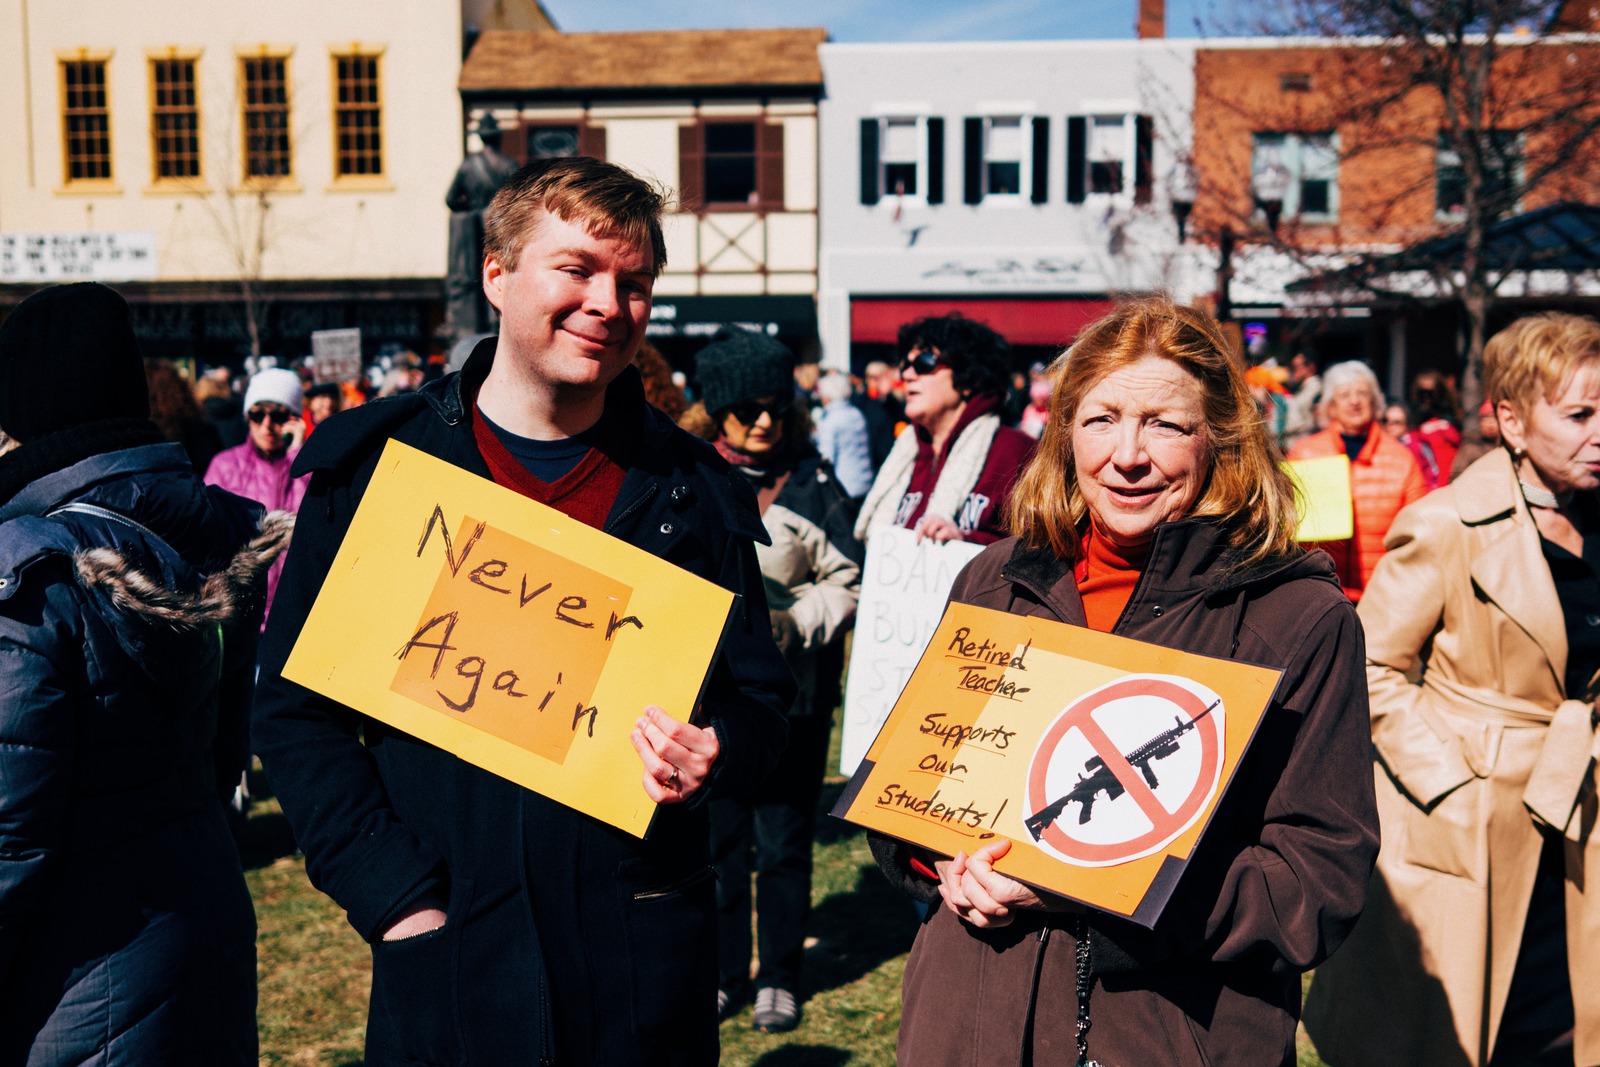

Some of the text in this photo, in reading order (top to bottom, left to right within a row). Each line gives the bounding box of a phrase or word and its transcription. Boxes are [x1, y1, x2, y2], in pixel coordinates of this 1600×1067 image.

[416, 502, 644, 642] Never
[947, 627, 1030, 670] Retired
[393, 610, 598, 738] Again
[958, 665, 1030, 700] Teacher
[919, 712, 1016, 750] Supports
[877, 783, 1009, 840] Students!
